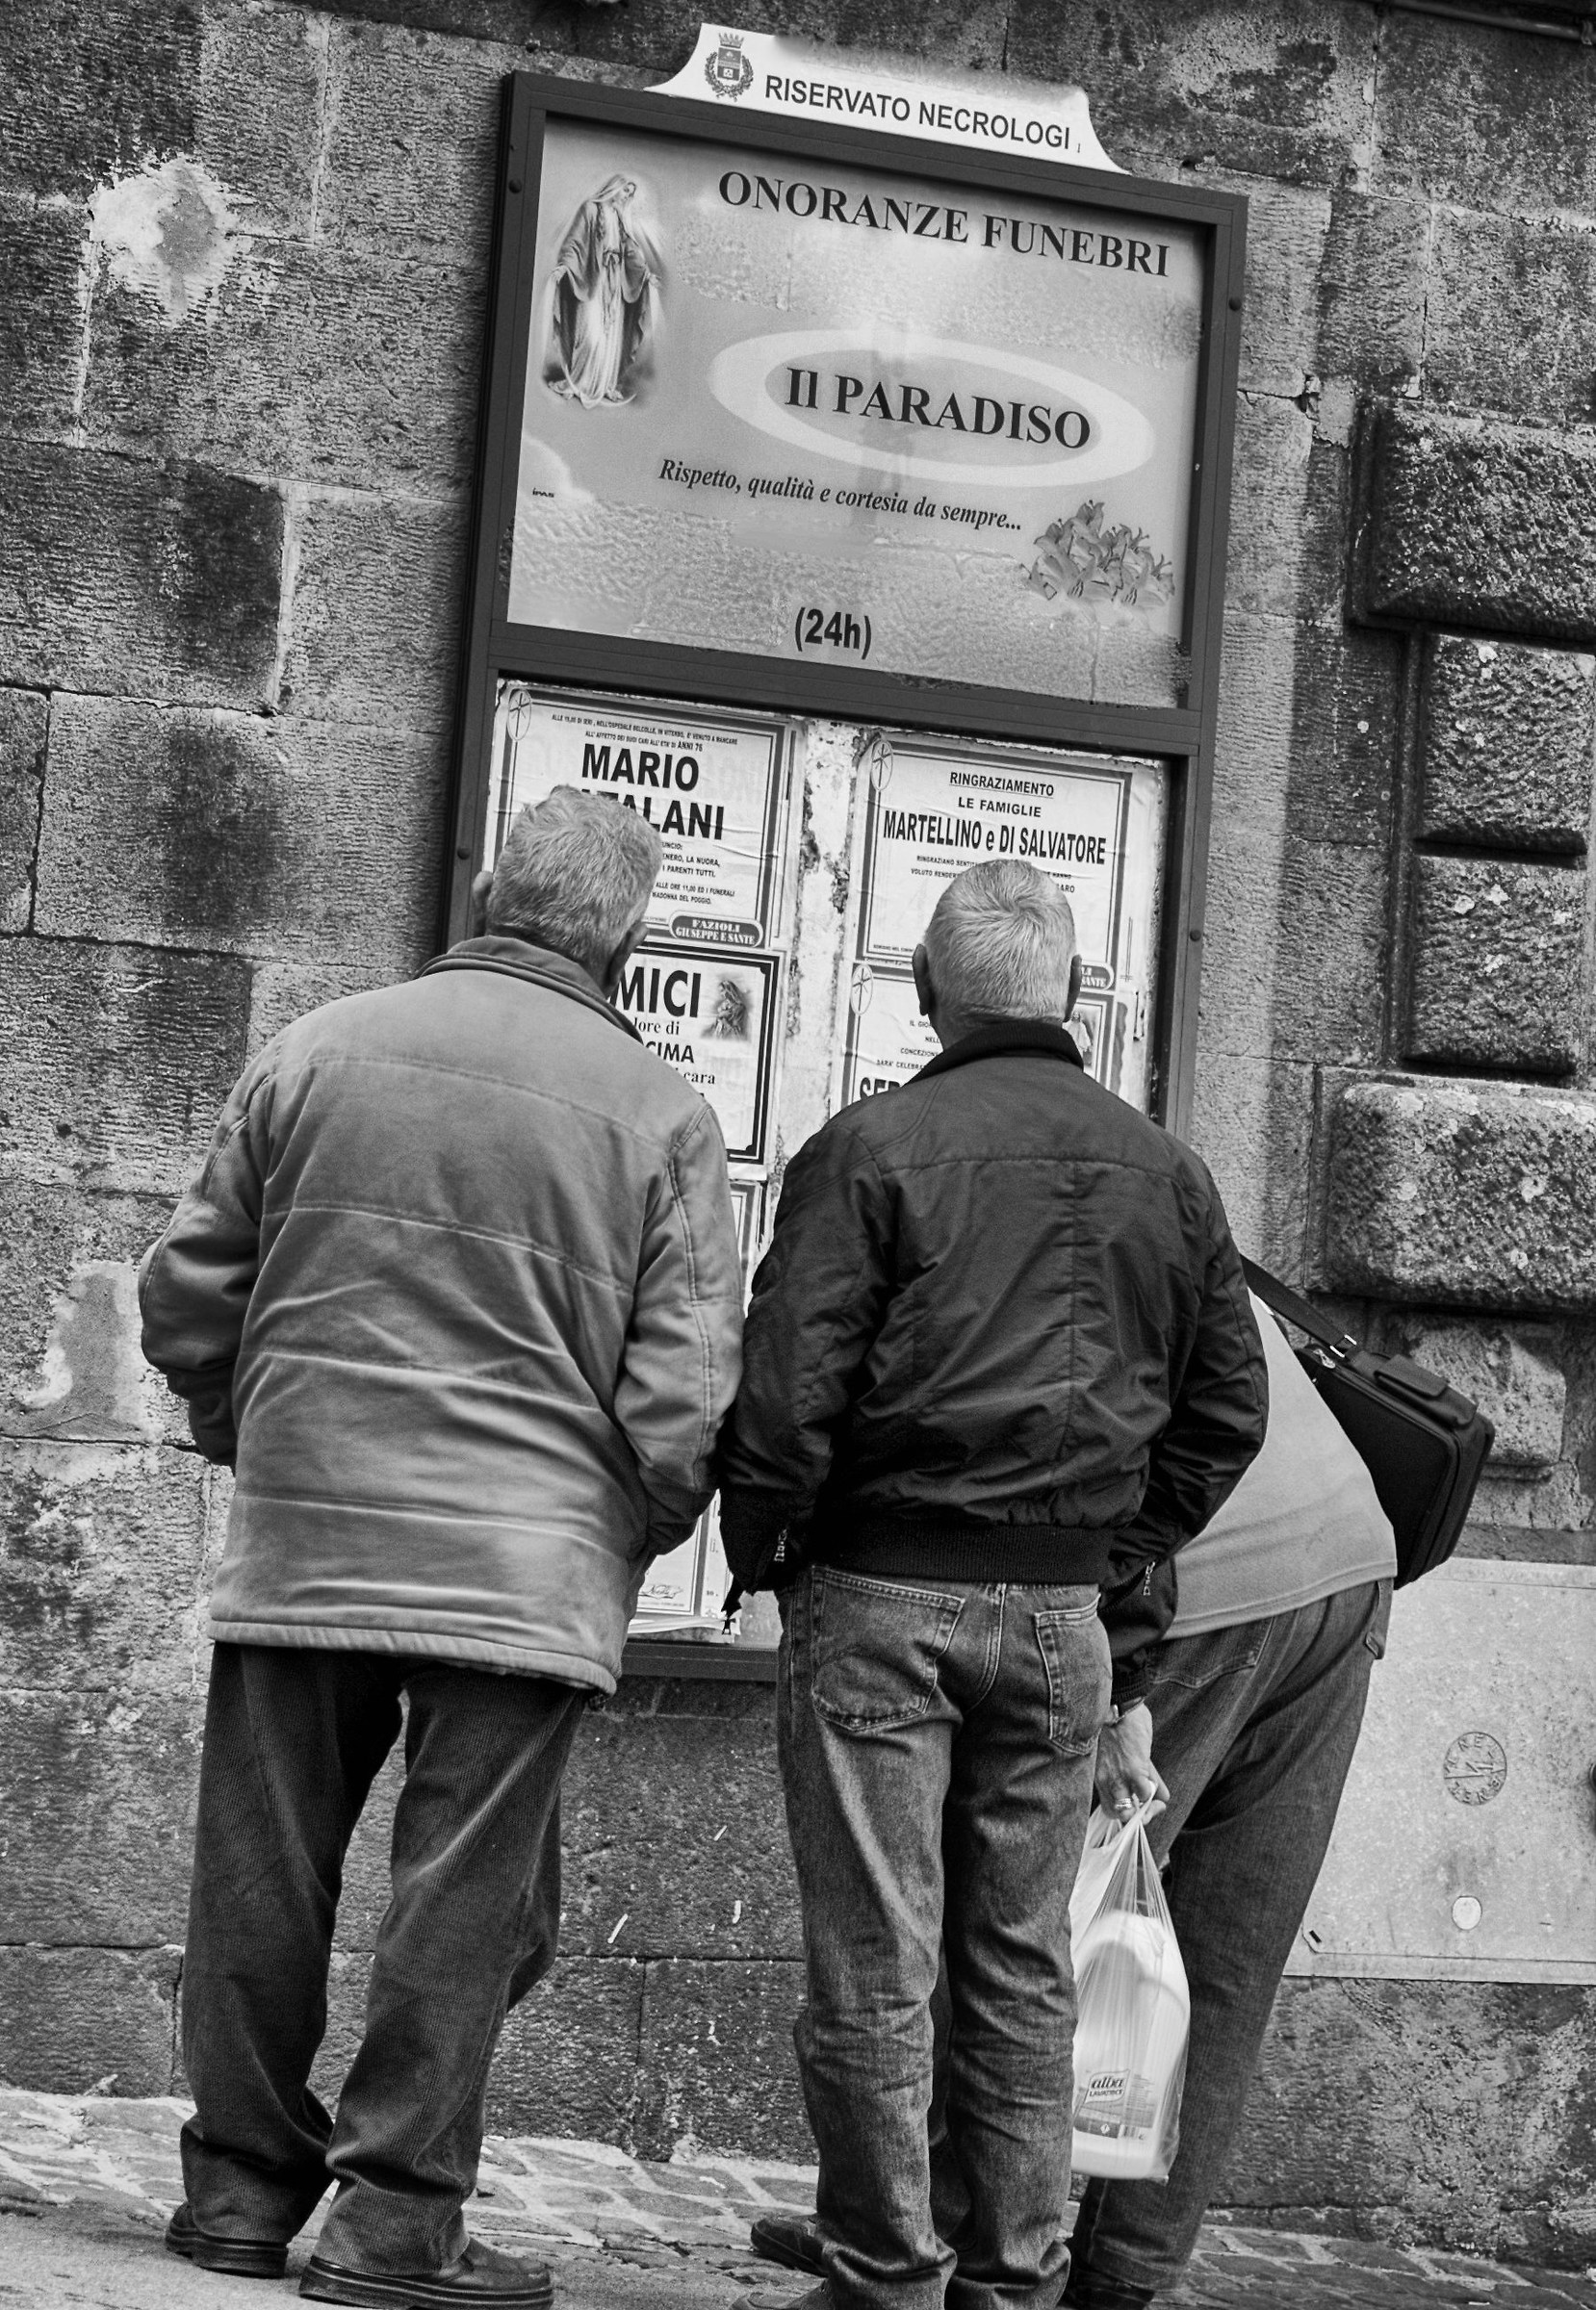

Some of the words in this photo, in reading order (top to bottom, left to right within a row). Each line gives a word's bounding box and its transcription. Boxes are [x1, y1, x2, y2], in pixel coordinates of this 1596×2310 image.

[765, 74, 911, 121] RISERVATO
[918, 101, 1070, 150] NECROLOGI
[718, 170, 969, 244] ONORANZE
[981, 214, 1171, 277] FUNEBRI
[832, 374, 1092, 449] PARADISO
[658, 458, 742, 494] Rispetto,
[748, 475, 814, 502] qualità
[819, 486, 832, 502] e
[836, 490, 909, 515] cortesia
[913, 496, 938, 519] da
[940, 503, 1022, 531] sempre...
[794, 606, 872, 659] (24h)
[581, 743, 700, 792] MARIO
[949, 772, 1054, 797] RINGRAZIAMENTO
[958, 797, 974, 809] LE
[979, 800, 1042, 818] FAMIGLIE
[883, 810, 982, 850] MARTELLINO
[986, 830, 994, 851] e
[998, 825, 1016, 854] DI
[1018, 827, 1106, 865] SALVATORE
[666, 865, 693, 875] PARENTI
[675, 927, 720, 941] GIUSEPPE
[727, 933, 756, 945] SANTE
[692, 919, 741, 933] FAZIOLI
[609, 965, 702, 1018] MICI
[634, 1016, 661, 1035] lore
[665, 1020, 680, 1036] di
[900, 1047, 938, 1057] CONCEZION
